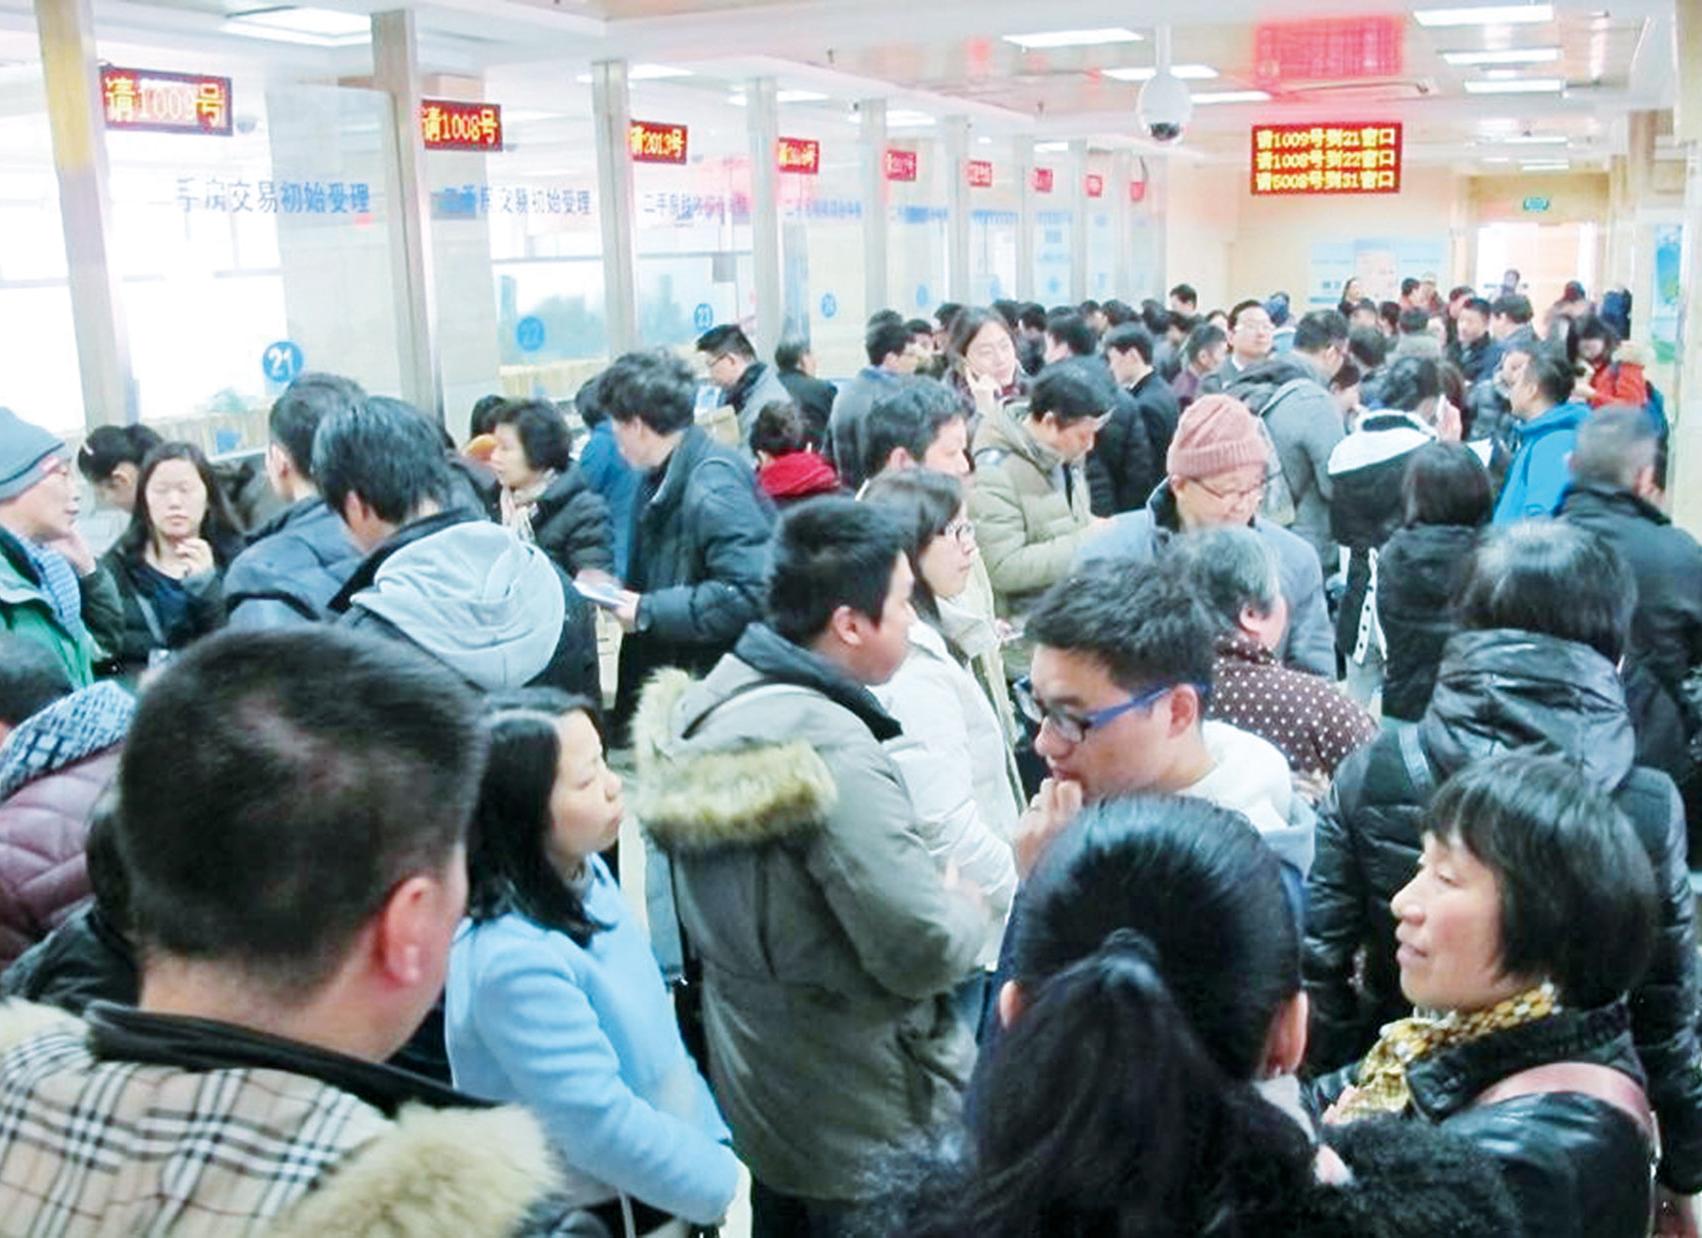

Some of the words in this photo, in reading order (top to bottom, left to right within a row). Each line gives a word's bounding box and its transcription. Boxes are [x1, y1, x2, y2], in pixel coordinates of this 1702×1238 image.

[421, 106, 498, 144] 请1008号
[1257, 128, 1395, 149] 请1009号到21窗口
[148, 178, 372, 214] 手房交易初始受理
[268, 347, 293, 377] 21
